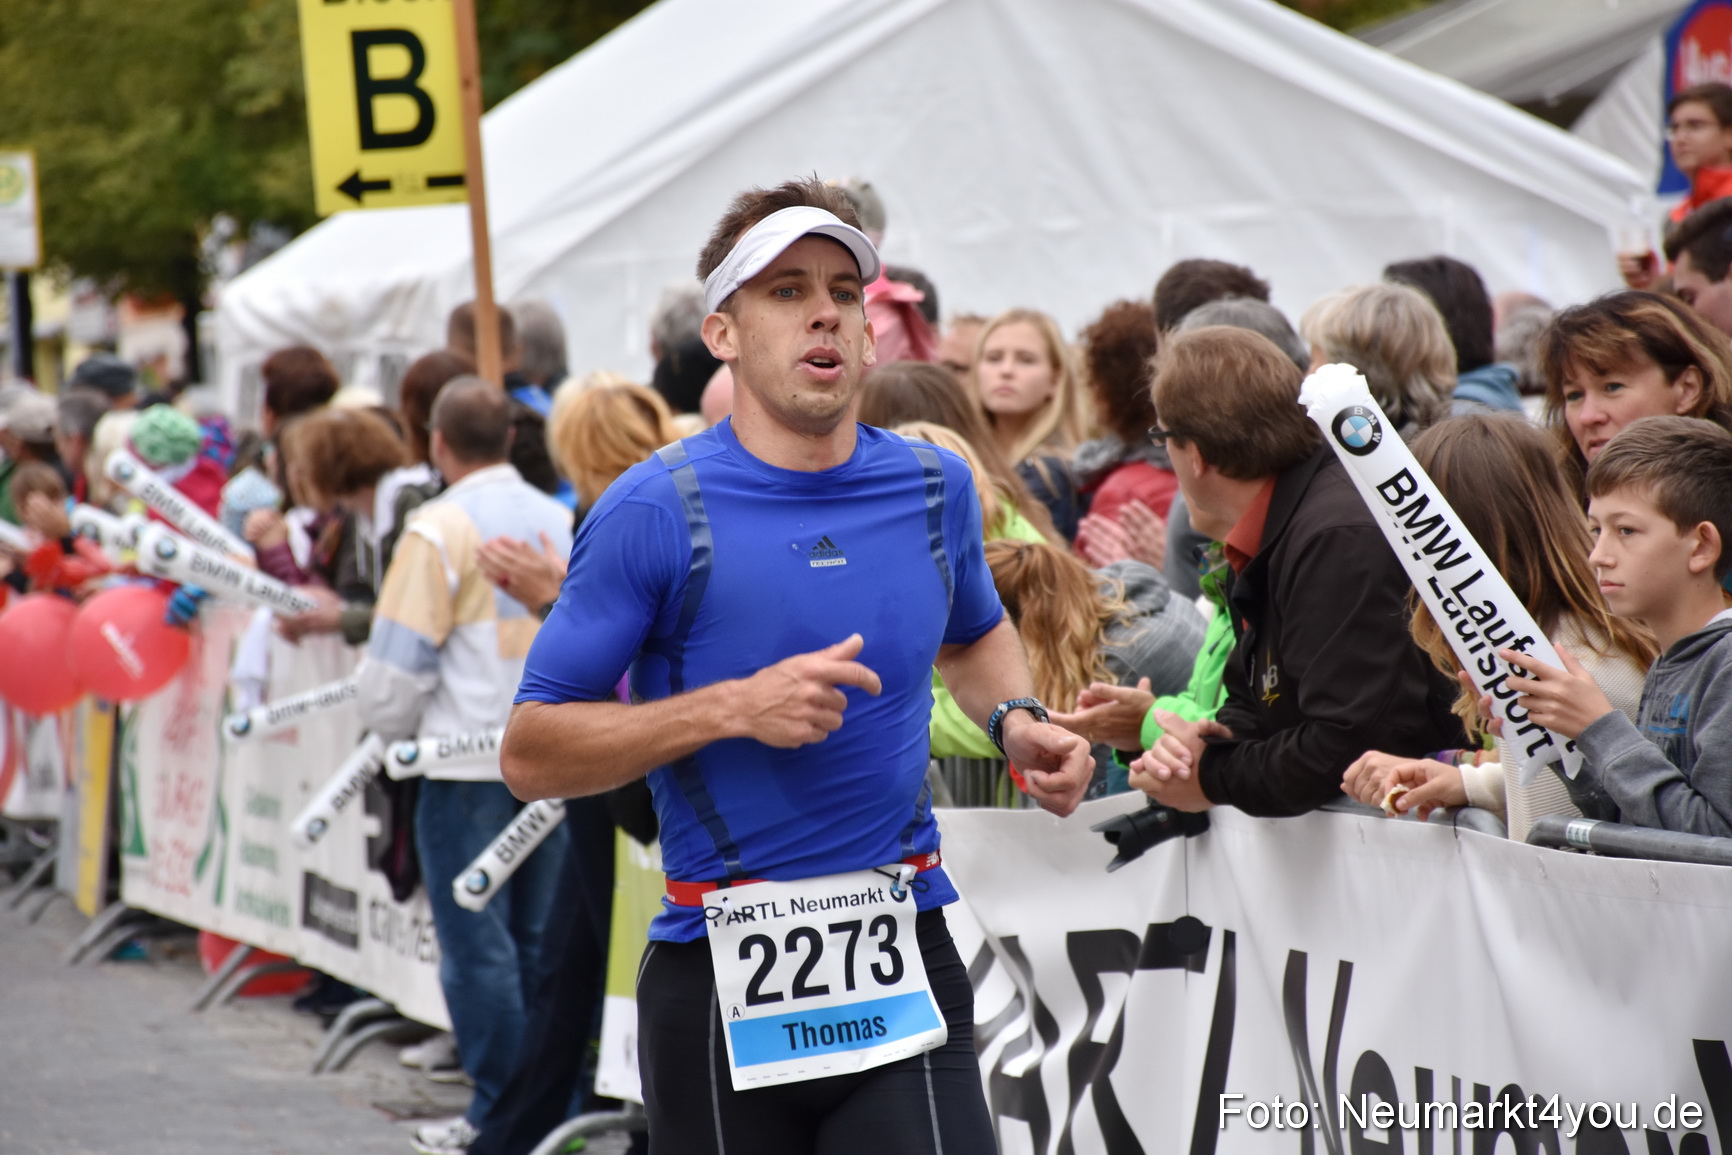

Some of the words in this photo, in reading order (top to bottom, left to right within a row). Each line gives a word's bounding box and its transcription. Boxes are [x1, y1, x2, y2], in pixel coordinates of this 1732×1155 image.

[350, 27, 437, 152] B
[1376, 466, 1473, 572] BMW
[809, 549, 845, 559] adidas
[437, 737, 497, 759] BMW
[495, 808, 549, 864] BMW
[712, 901, 786, 928] ARTL
[790, 887, 885, 916] Neumarkt
[738, 913, 905, 1008] 2273
[732, 1006, 741, 1018] A
[782, 1015, 888, 1051] Thomas
